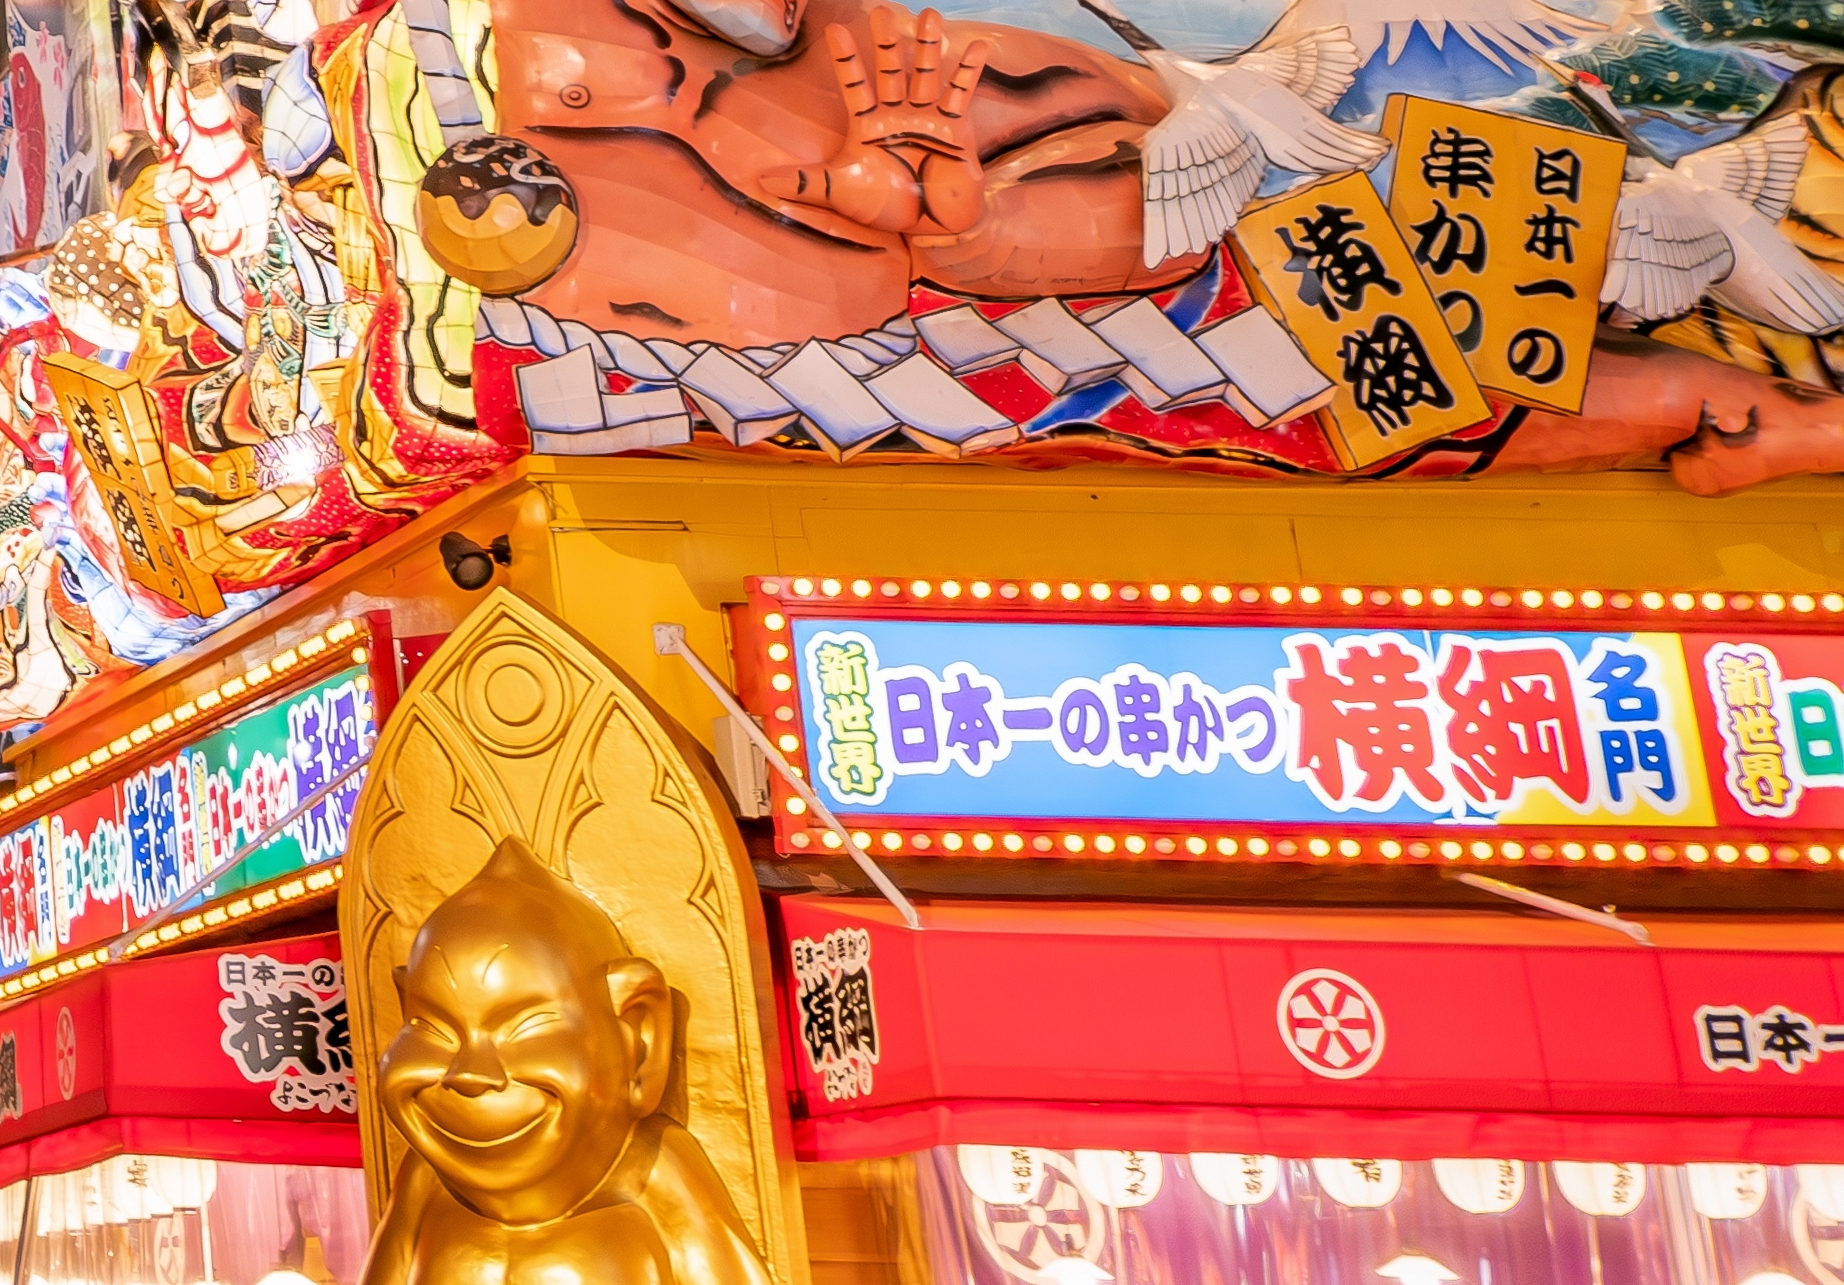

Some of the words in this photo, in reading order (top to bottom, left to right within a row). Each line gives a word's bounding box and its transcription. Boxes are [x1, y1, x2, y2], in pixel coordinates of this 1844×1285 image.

[1274, 201, 1455, 440] 横綱
[1508, 144, 1583, 388] 日本一の
[820, 640, 879, 795] 新世界
[883, 667, 1280, 768] 日本一の串かつ
[1287, 637, 1591, 807] 横綱
[1587, 650, 1677, 805] 名門
[1715, 650, 1788, 810] 新世界
[225, 960, 345, 988] 日本一の
